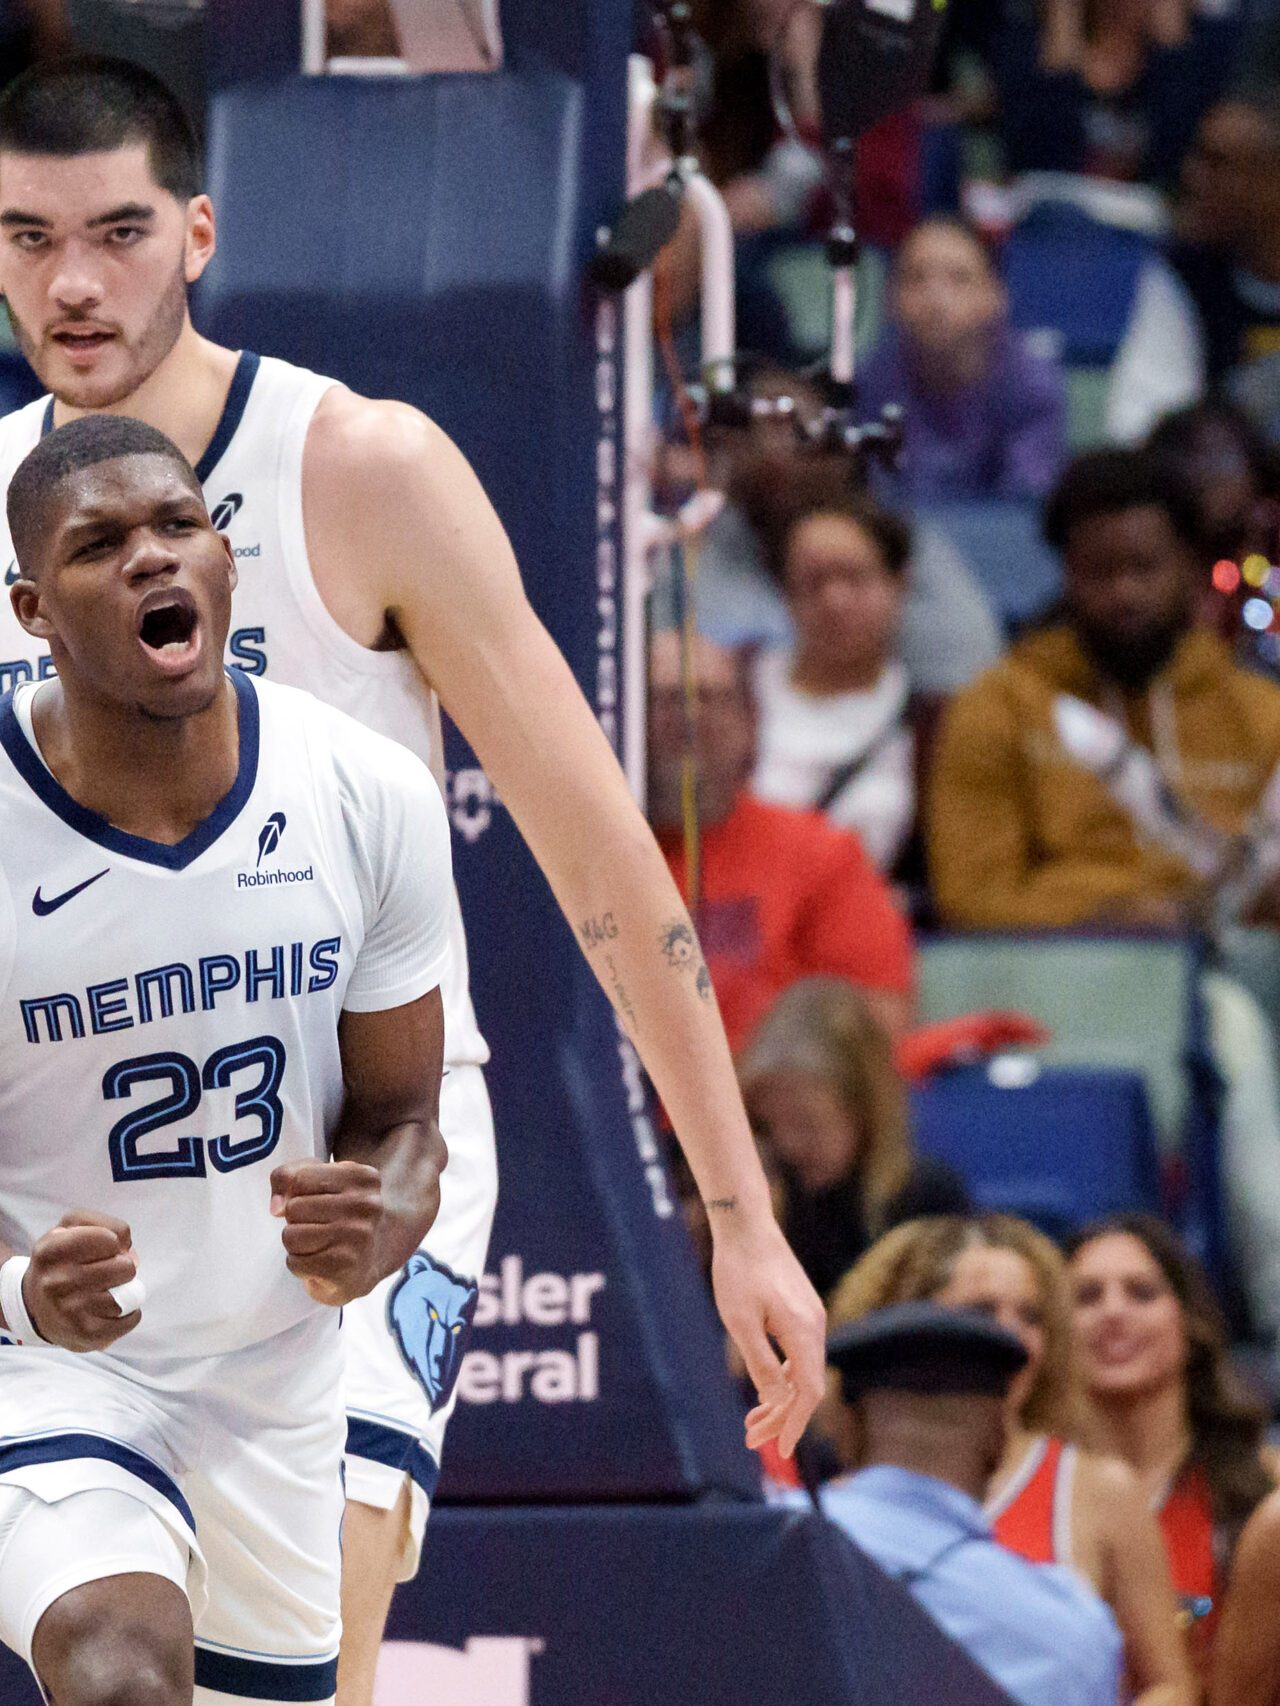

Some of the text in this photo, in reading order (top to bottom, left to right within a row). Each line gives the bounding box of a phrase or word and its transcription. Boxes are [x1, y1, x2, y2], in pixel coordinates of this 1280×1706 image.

[237, 866, 314, 888] Robinhood
[19, 936, 342, 1044] MEMPHIS
[102, 1035, 287, 1183] 23
[473, 1255, 606, 1327] sler
[456, 1331, 599, 1403] eral
